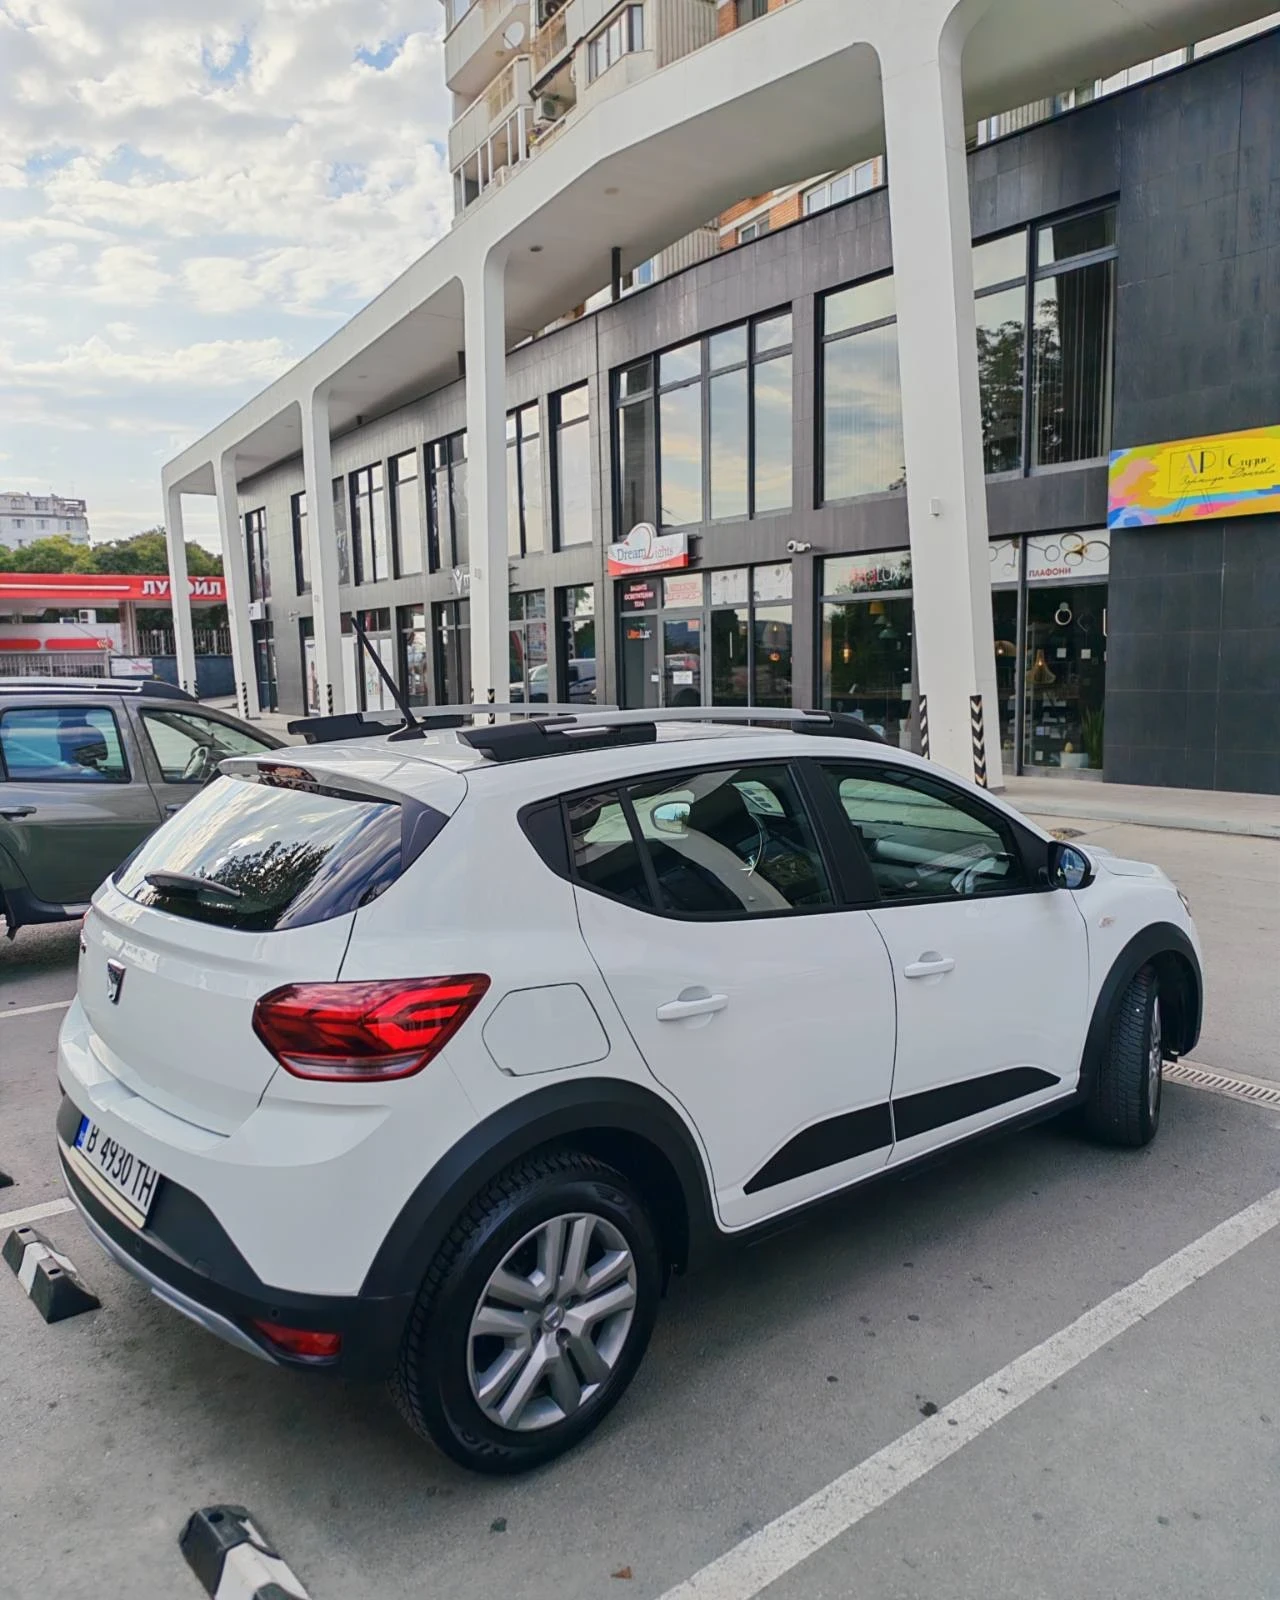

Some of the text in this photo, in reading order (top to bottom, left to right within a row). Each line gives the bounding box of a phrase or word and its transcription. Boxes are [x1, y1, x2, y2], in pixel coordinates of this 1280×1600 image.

[1028, 567, 1072, 578] ПЛАФОНИ
[142, 576, 222, 596] ЛУЙЛ
[100, 1137, 134, 1186] 4930
[131, 1159, 157, 1208] TH
